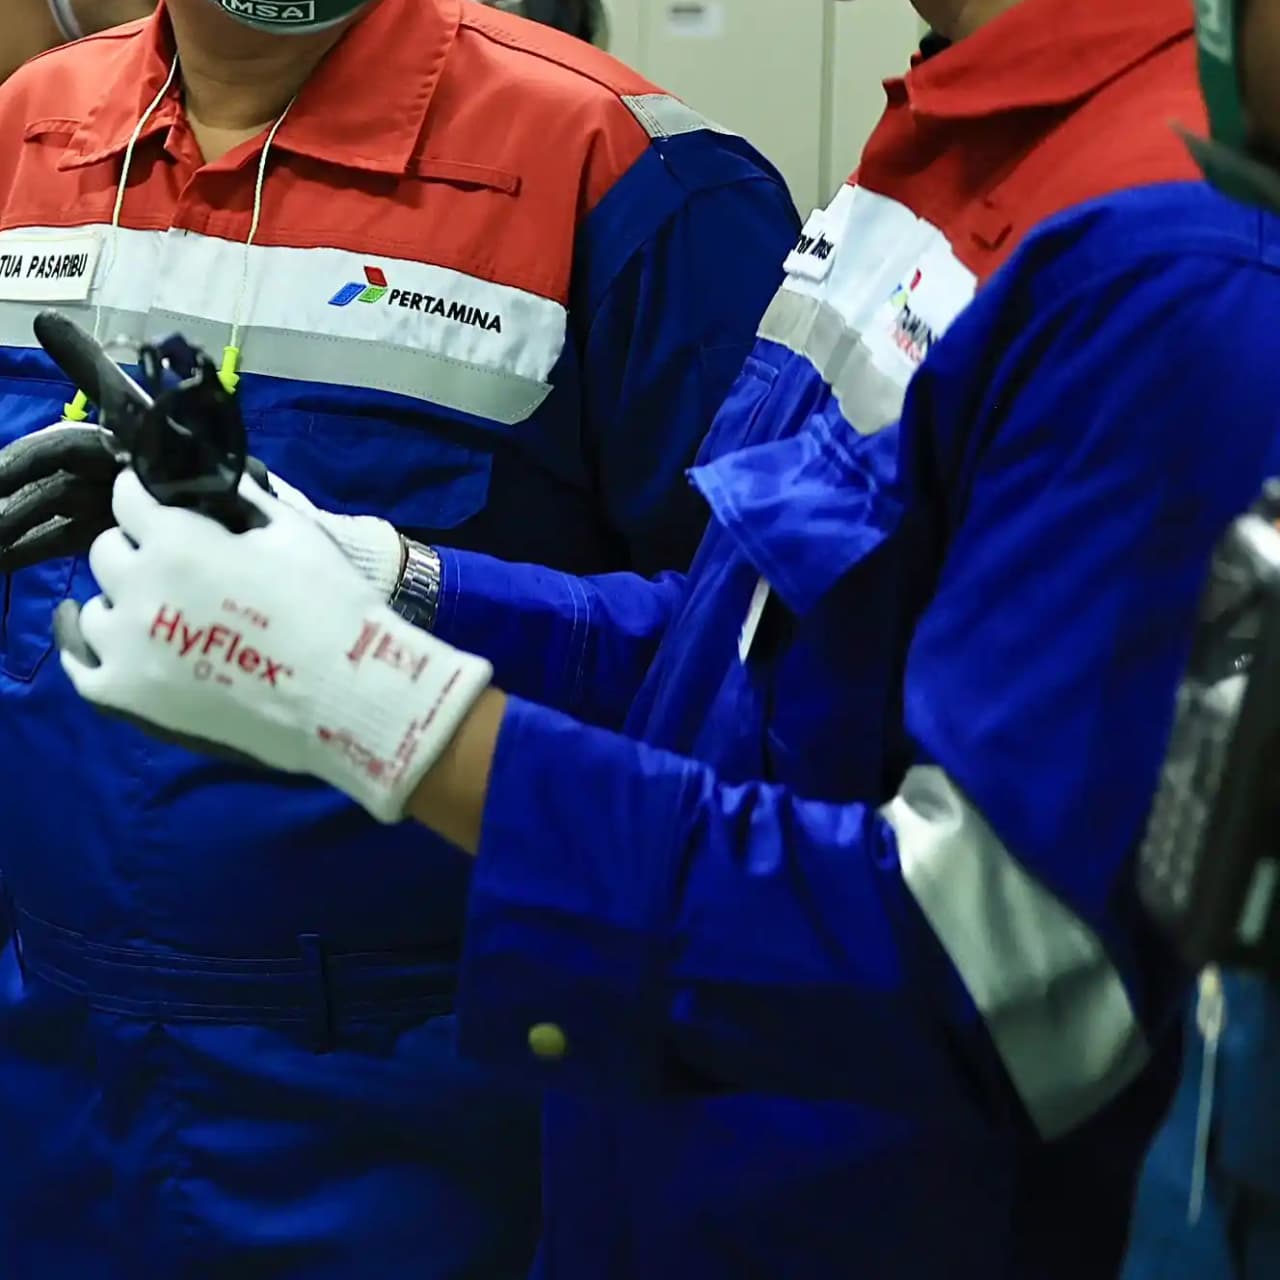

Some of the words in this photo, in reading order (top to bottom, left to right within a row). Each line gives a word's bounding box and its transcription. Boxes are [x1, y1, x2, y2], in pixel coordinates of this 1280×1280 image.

[26, 253, 88, 280] PASARIBU
[388, 288, 501, 334] PERTAMINA
[149, 604, 278, 688] HyFlex
